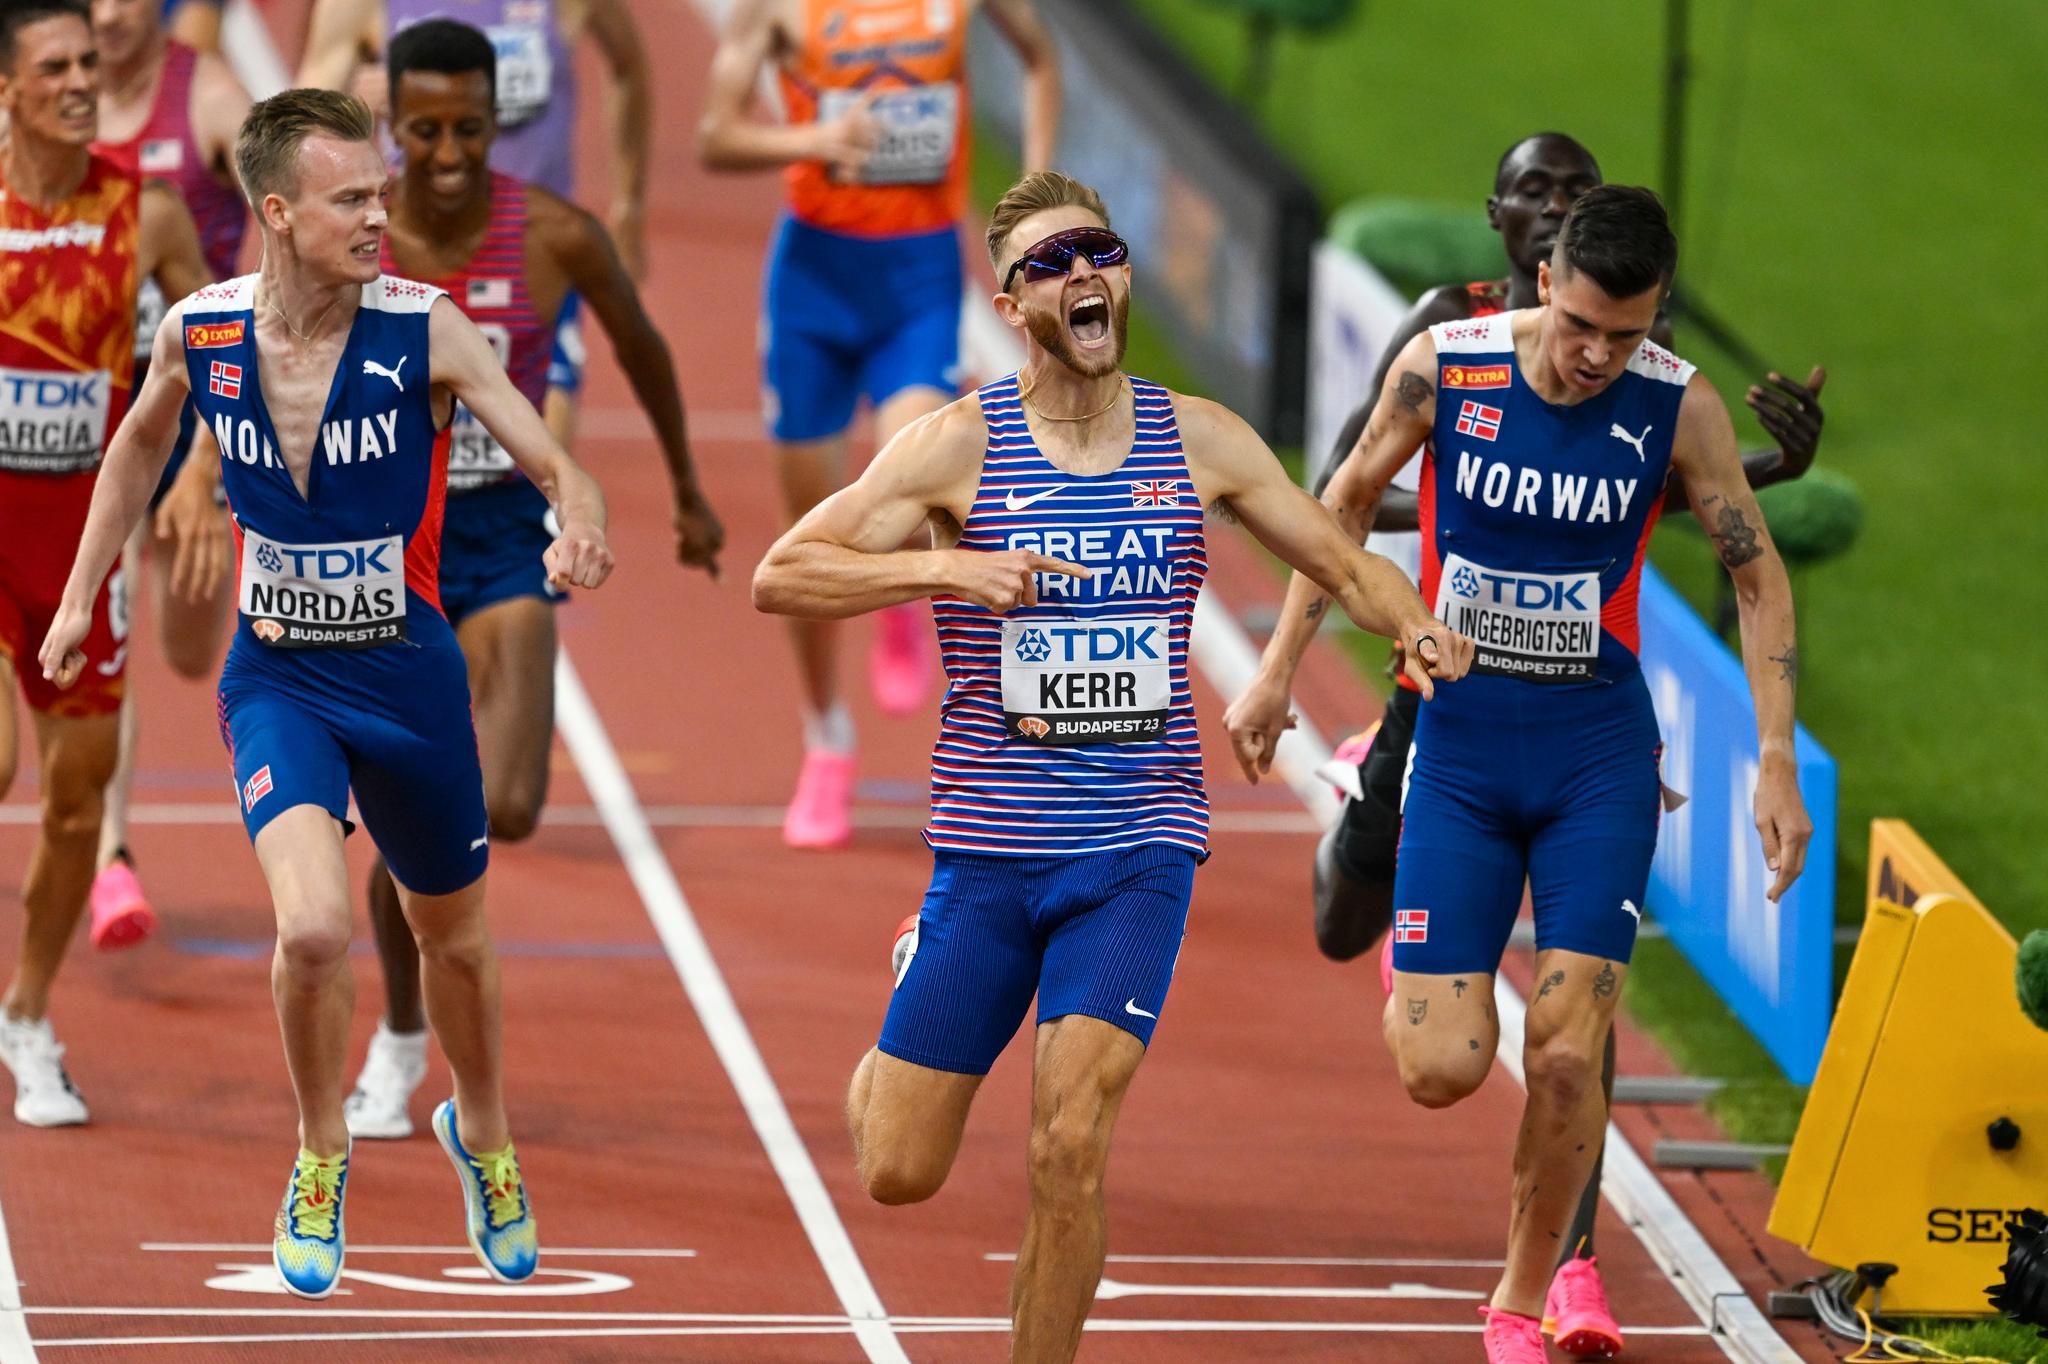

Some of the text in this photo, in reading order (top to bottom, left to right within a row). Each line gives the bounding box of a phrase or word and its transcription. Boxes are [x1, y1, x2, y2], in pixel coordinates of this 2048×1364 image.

[210, 326, 243, 342] EXTRA
[5, 376, 97, 409] TDK
[1466, 370, 1507, 384] EXTRA
[1456, 450, 1638, 524] NORWAY
[281, 543, 392, 580] TDK
[1008, 528, 1173, 562] GREAT
[1032, 564, 1173, 598] RITAIN
[1480, 573, 1589, 612] TDK
[250, 583, 396, 623] NORDÅS
[289, 625, 398, 643] BUDAPEST 23
[1050, 626, 1160, 662] TDK
[1459, 606, 1594, 654] INGEBRIGTSEN
[1478, 653, 1588, 676] BUDAPEST 23
[1039, 671, 1138, 710] KERR
[1055, 718, 1160, 736] BUDAPEST 23
